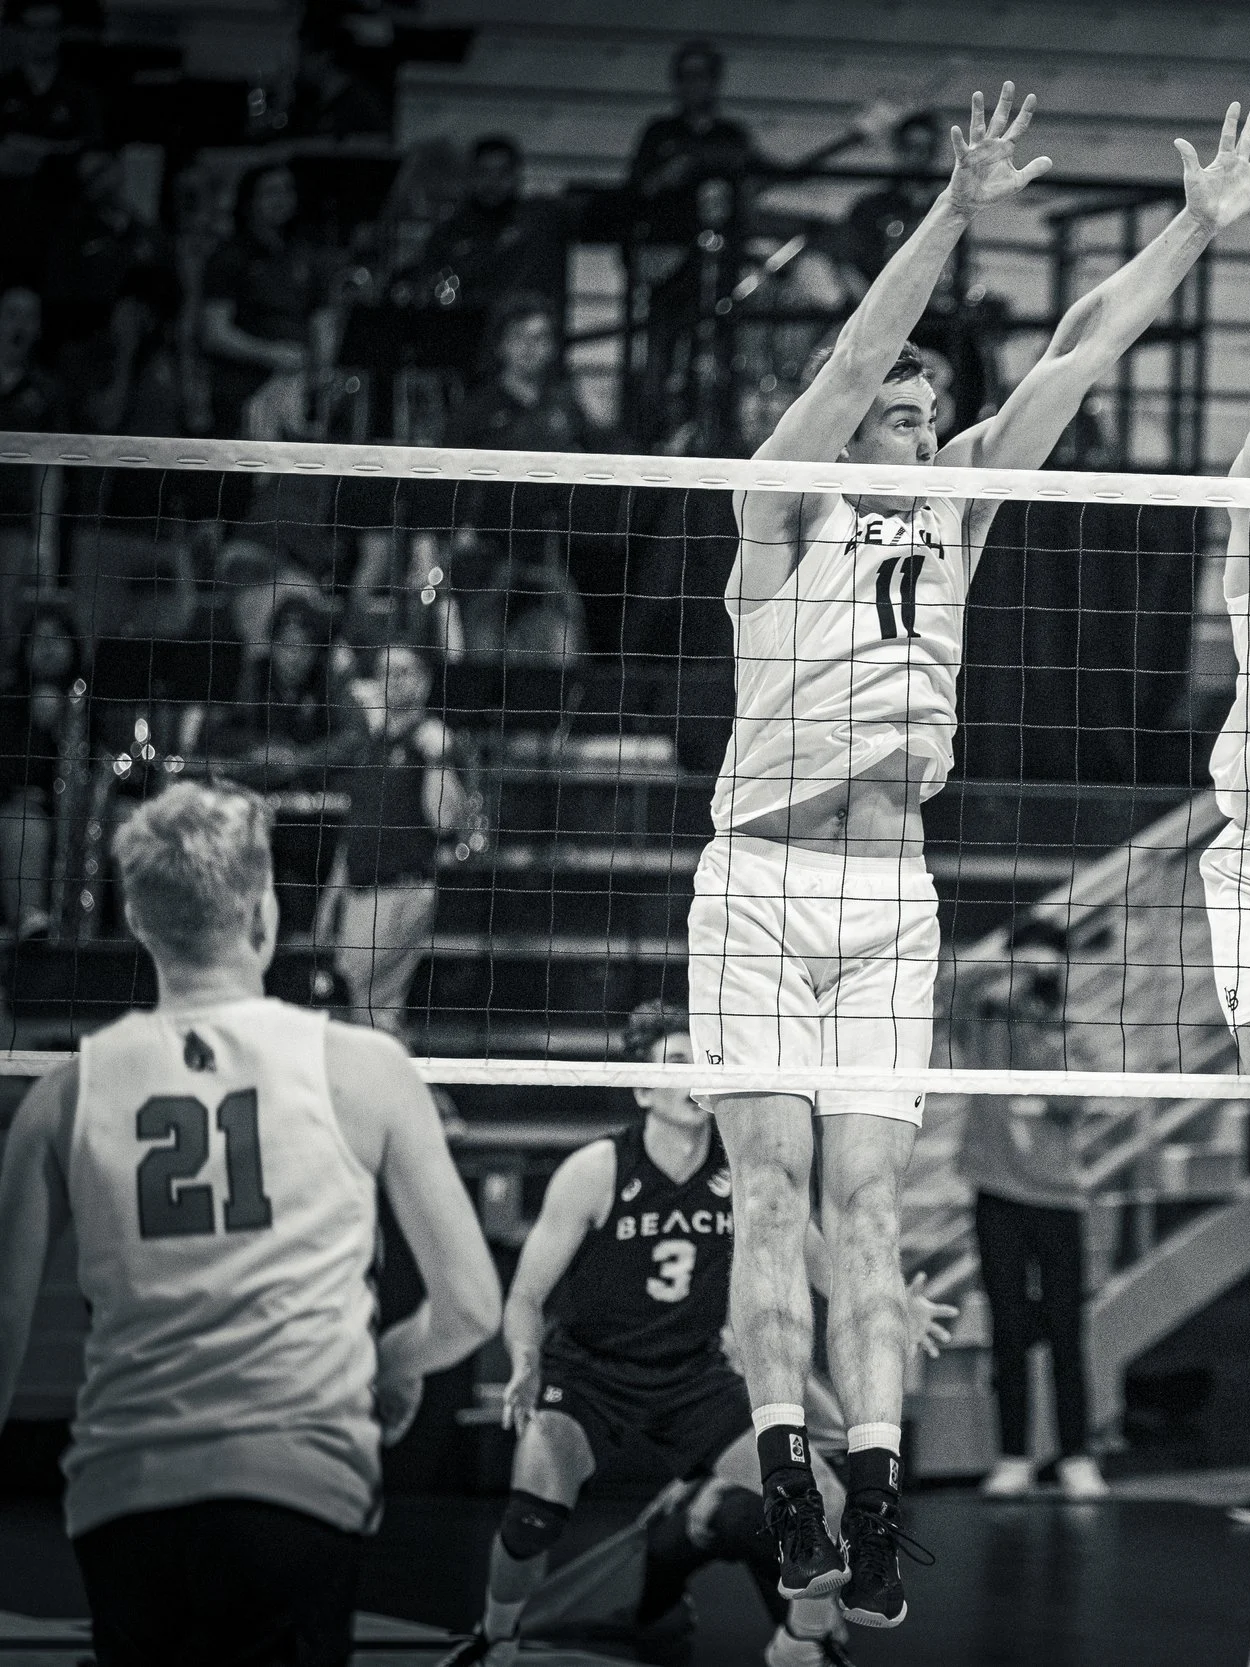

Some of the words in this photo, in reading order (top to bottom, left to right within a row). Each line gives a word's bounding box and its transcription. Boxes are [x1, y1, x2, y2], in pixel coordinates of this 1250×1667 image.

[875, 554, 925, 640] 11
[136, 1086, 273, 1240] 21
[615, 1208, 734, 1241] BEACH
[645, 1237, 698, 1303] 3
